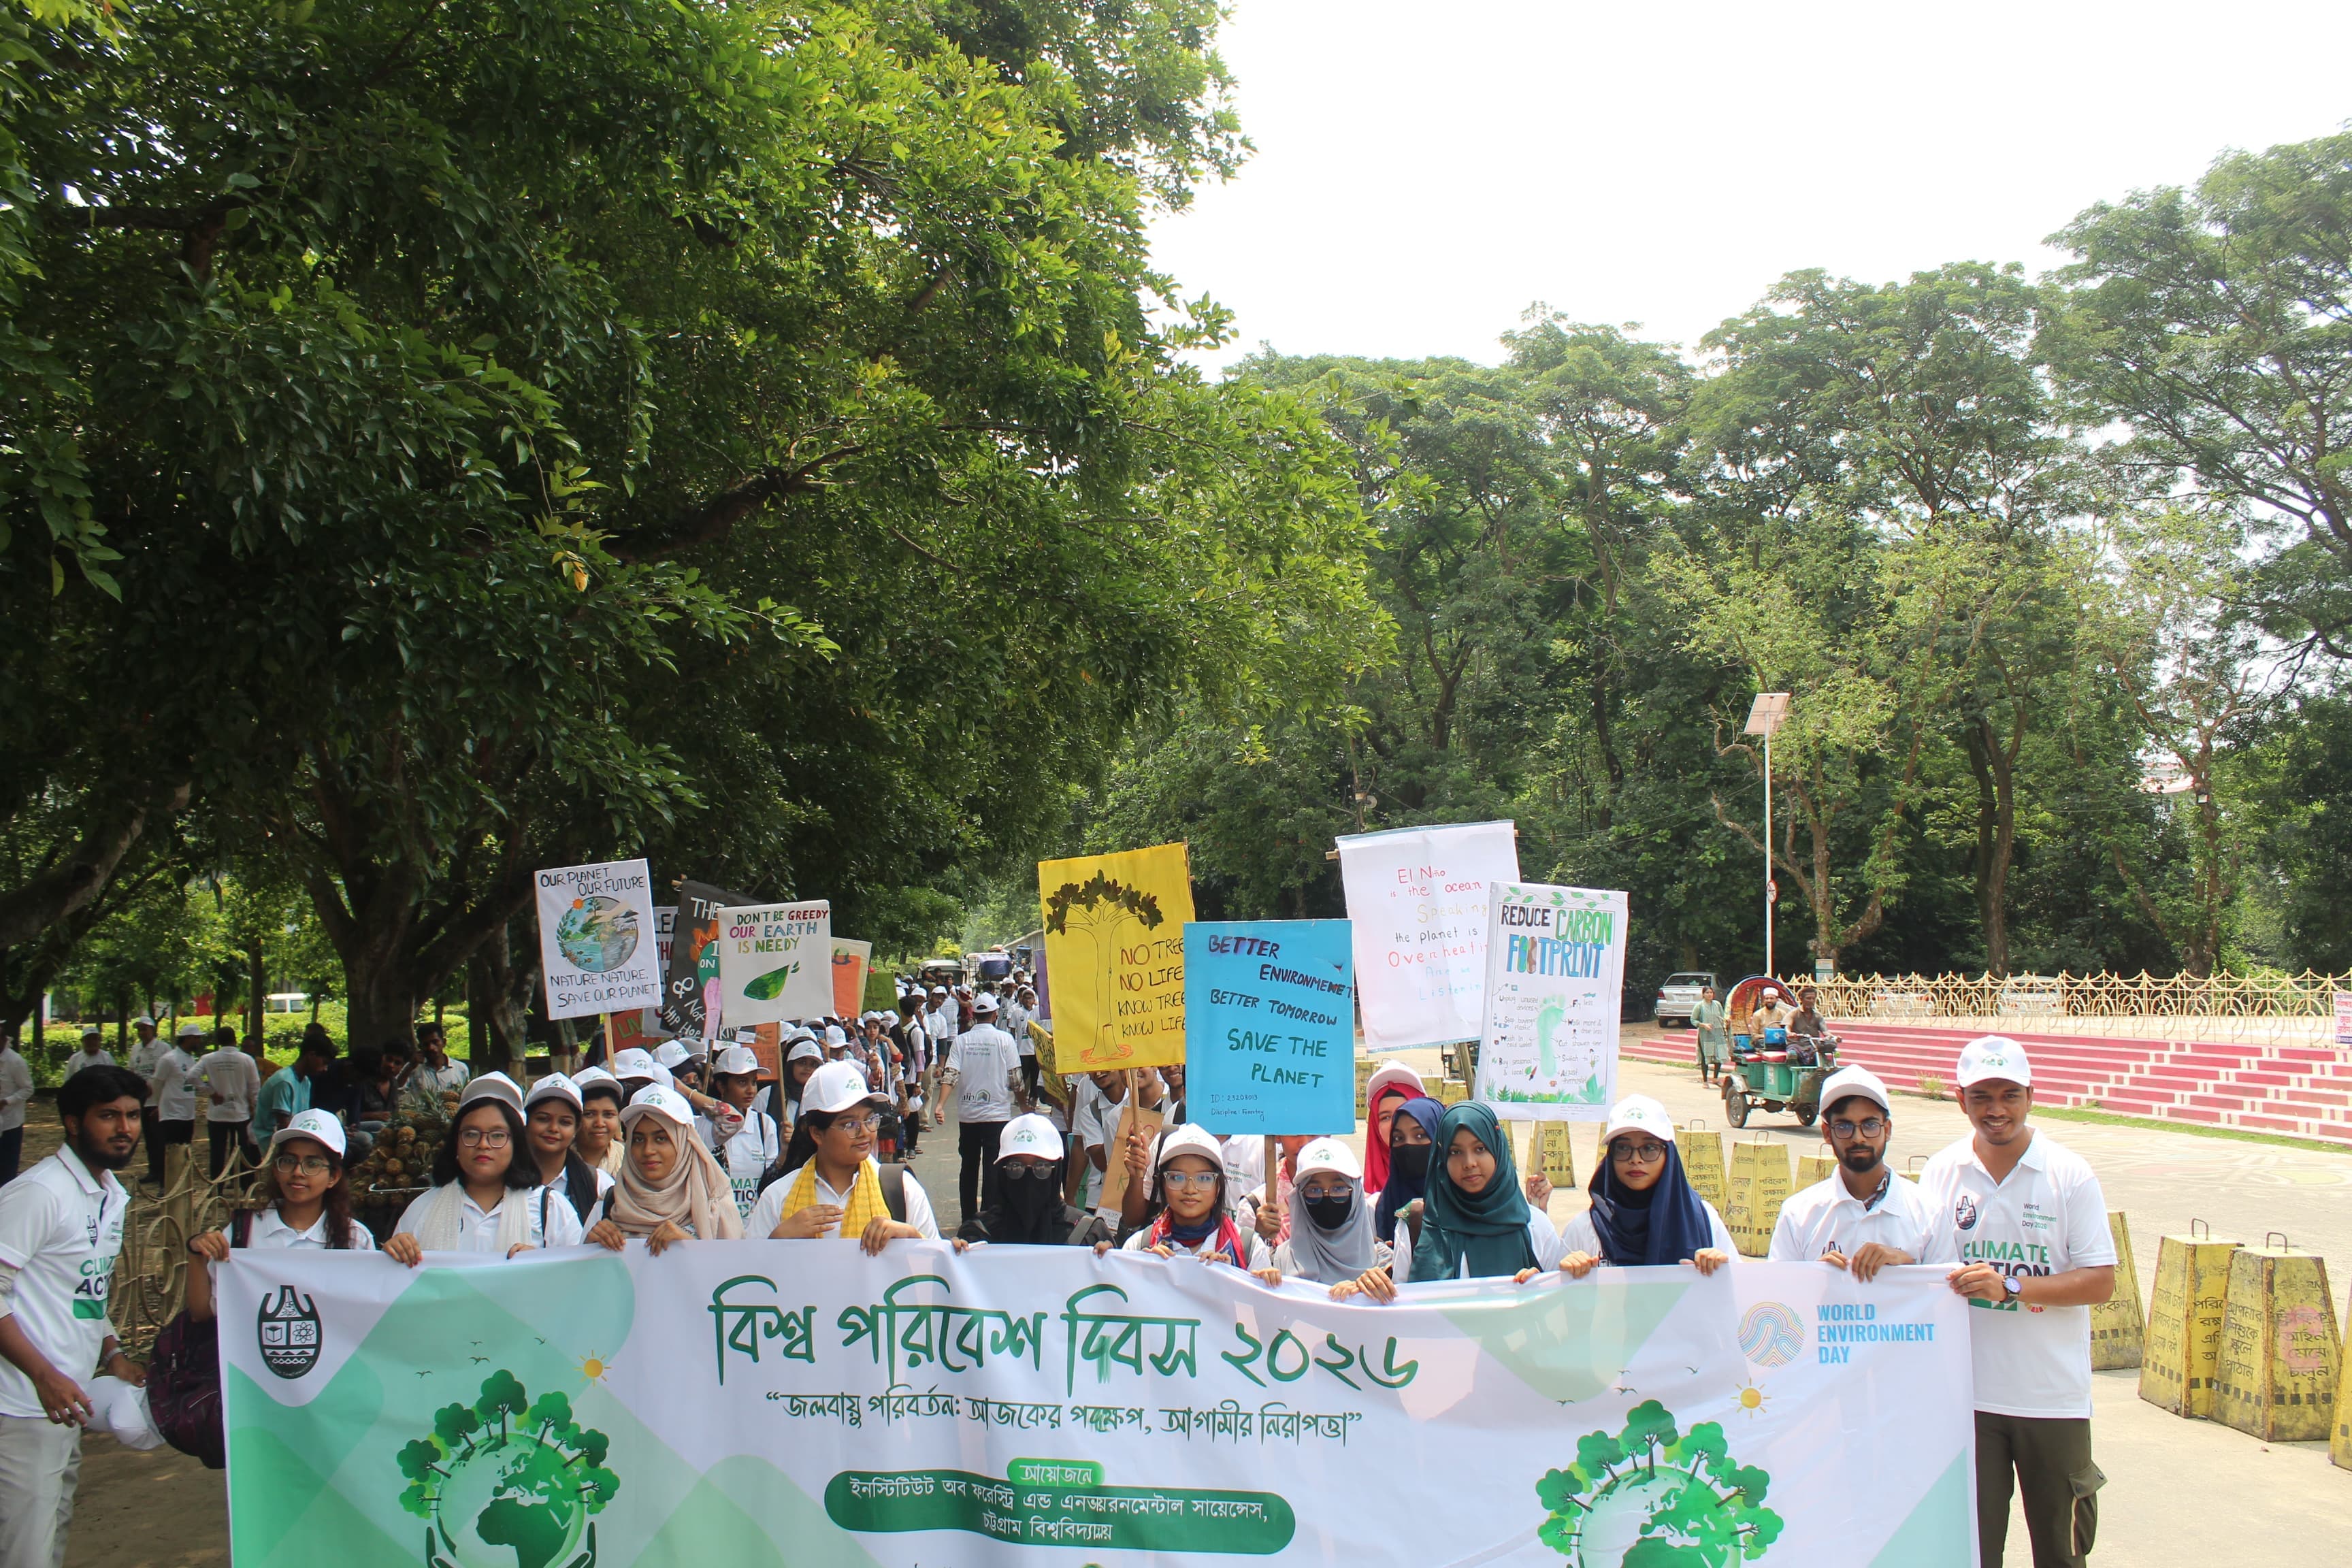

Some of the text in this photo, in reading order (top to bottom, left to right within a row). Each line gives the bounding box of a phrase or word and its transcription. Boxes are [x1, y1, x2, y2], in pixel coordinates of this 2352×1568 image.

[540, 868, 610, 887] OUR PLANET
[578, 876, 644, 896] OUR FUTURE
[1409, 886, 1431, 896] the
[1445, 881, 1482, 893] ocean
[737, 910, 828, 926] DON'T BE GREEDY
[1501, 904, 1613, 945] REDUCE CARBON
[730, 921, 817, 938] OUR EARTH
[1395, 926, 1478, 945] the planet is
[738, 937, 800, 953] IS NEEDY
[1121, 944, 1150, 965] NO
[1208, 934, 1280, 960] BETTER
[700, 959, 715, 968] ON
[1506, 934, 1605, 979] FOOTPRINT
[550, 973, 598, 987] NATURE
[1120, 965, 1185, 992] NO LIFE
[557, 983, 657, 1007] SAVE OUR PLANET
[1117, 1000, 1153, 1016] KNOW
[1210, 989, 1337, 1026] BETTER TOMORROW
[1122, 1020, 1154, 1039] KNOW
[1227, 1028, 1328, 1057] SAVE THE
[1251, 1063, 1324, 1088] PLANET
[2023, 1203, 2040, 1211] World
[2023, 1211, 2057, 1222] Environment
[2022, 1220, 2034, 1229] Day
[1963, 1240, 2050, 1264] CLIMATE
[1816, 1304, 1876, 1321] WORLD
[707, 1275, 1419, 1398] বিশ্ব পরিবেশ দিবস ২০২৬
[1818, 1324, 1935, 1343] ENVIRONMENT
[1818, 1345, 1850, 1364] DAY
[964, 1397, 1062, 1431] আজকের
[1159, 1399, 1252, 1444] আগামীর
[1019, 1463, 1092, 1486] আয়োজনে
[849, 1475, 935, 1499] ইনস্টিটিউট
[942, 1479, 967, 1497] অব
[970, 1482, 1015, 1510] ফরেস্ট্রি
[1023, 1492, 1052, 1510] এন্ড
[982, 1509, 1023, 1537] চট্টগ্রাম
